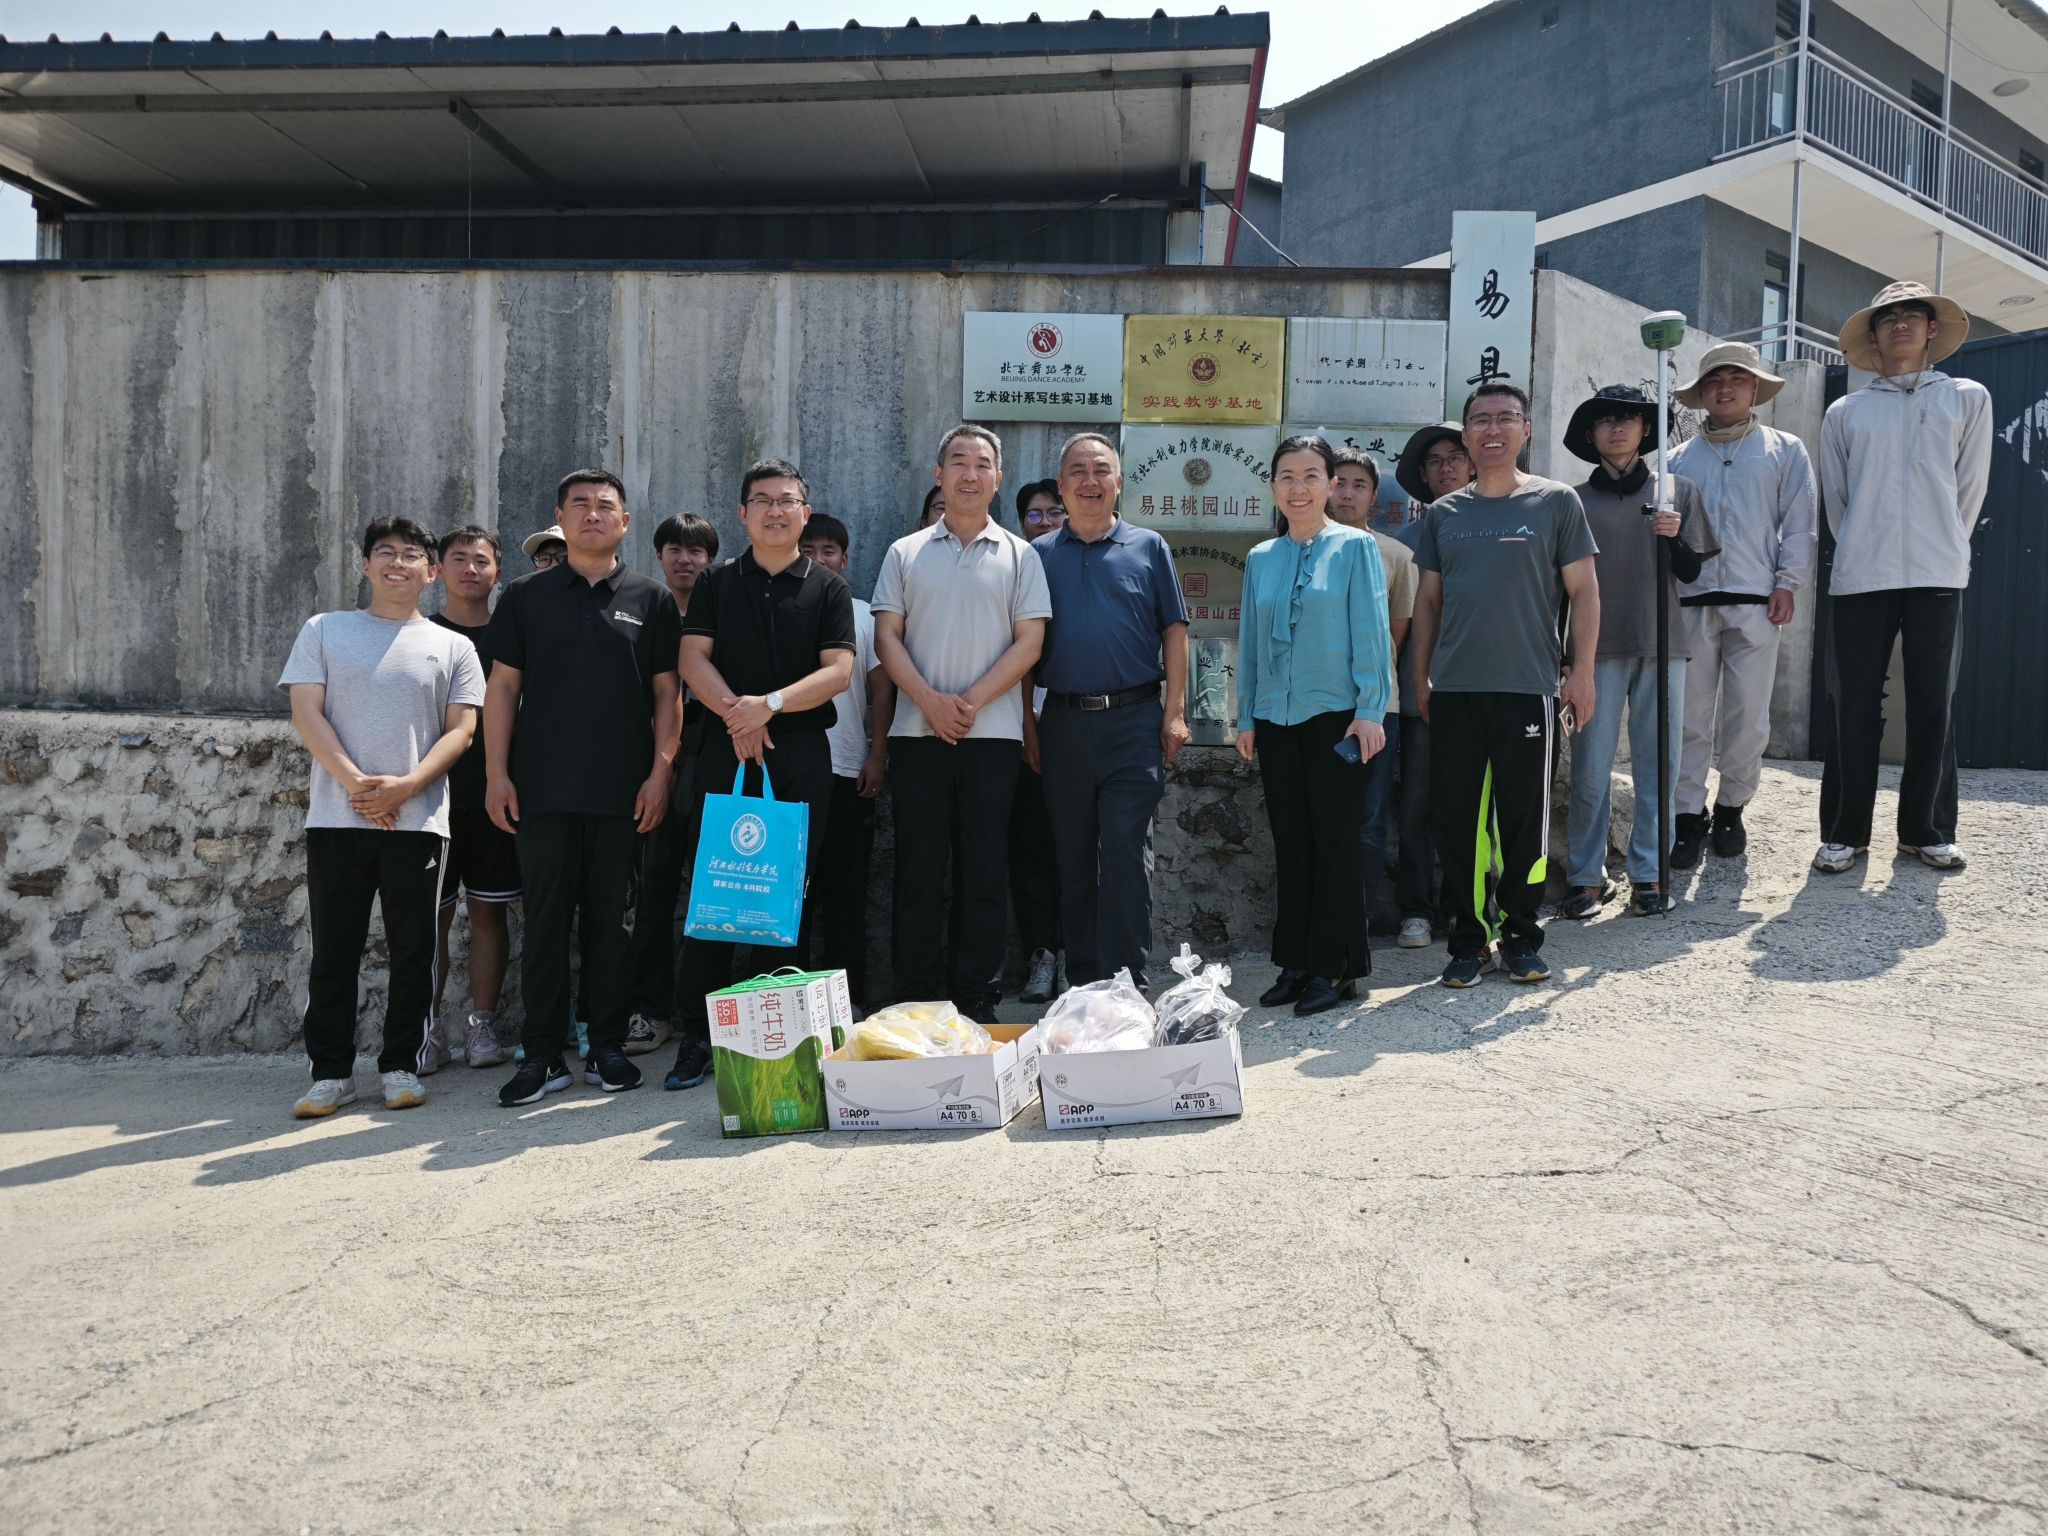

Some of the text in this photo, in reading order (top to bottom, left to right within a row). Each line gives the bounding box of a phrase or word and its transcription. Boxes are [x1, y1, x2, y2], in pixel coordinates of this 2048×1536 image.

[1000, 361, 1087, 377] 北京舞蹈学院
[1052, 376, 1086, 384] ACADEMY
[973, 390, 1113, 406] 艺术设计系写生实习基地
[1142, 395, 1264, 411] 实践教学基地
[1129, 436, 1271, 485] 河北水利电力学院测绘实习基地
[1139, 495, 1261, 517] 易县桃园山庄
[759, 992, 787, 1052] 纯牛奶
[1070, 1104, 1095, 1115] APP
[1175, 1101, 1190, 1111] A4
[1193, 1100, 1205, 1109] 70
[1209, 1098, 1216, 1107] 8
[849, 1109, 870, 1119] APP
[940, 1110, 977, 1121] A4 70 8
